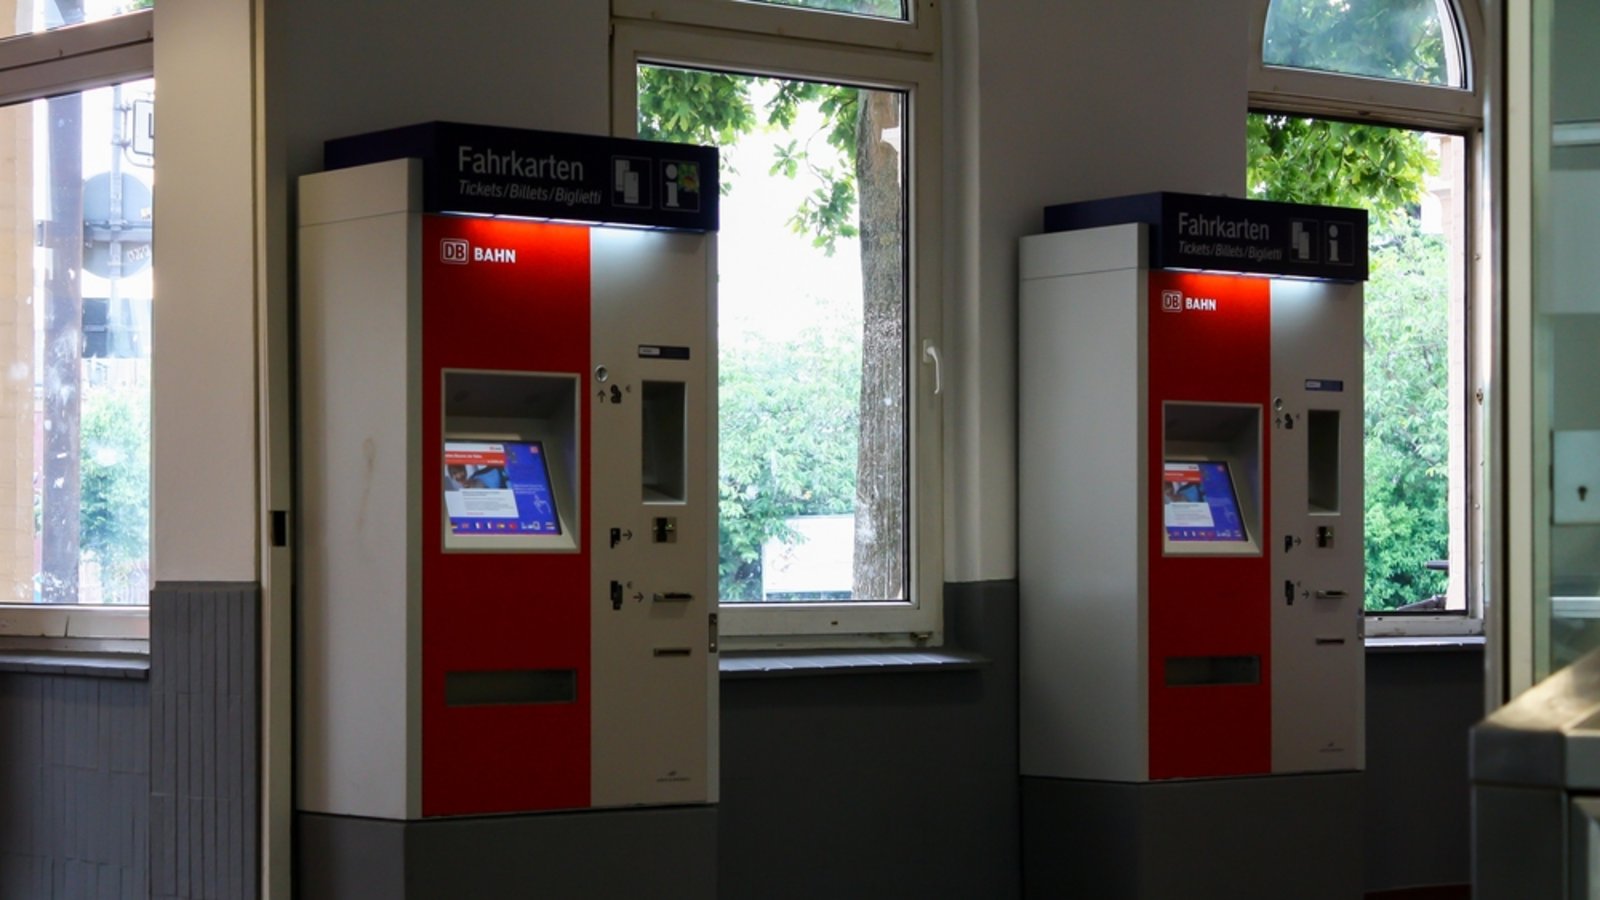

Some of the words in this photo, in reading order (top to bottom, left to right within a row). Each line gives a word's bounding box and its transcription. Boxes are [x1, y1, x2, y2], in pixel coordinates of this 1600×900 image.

[458, 146, 584, 182] Fahrkarten
[1178, 212, 1270, 241] Fahrkarten
[444, 242, 467, 260] DB
[473, 247, 517, 264] BAHN
[1164, 293, 1180, 308] DB
[1185, 297, 1218, 311] BAHN
